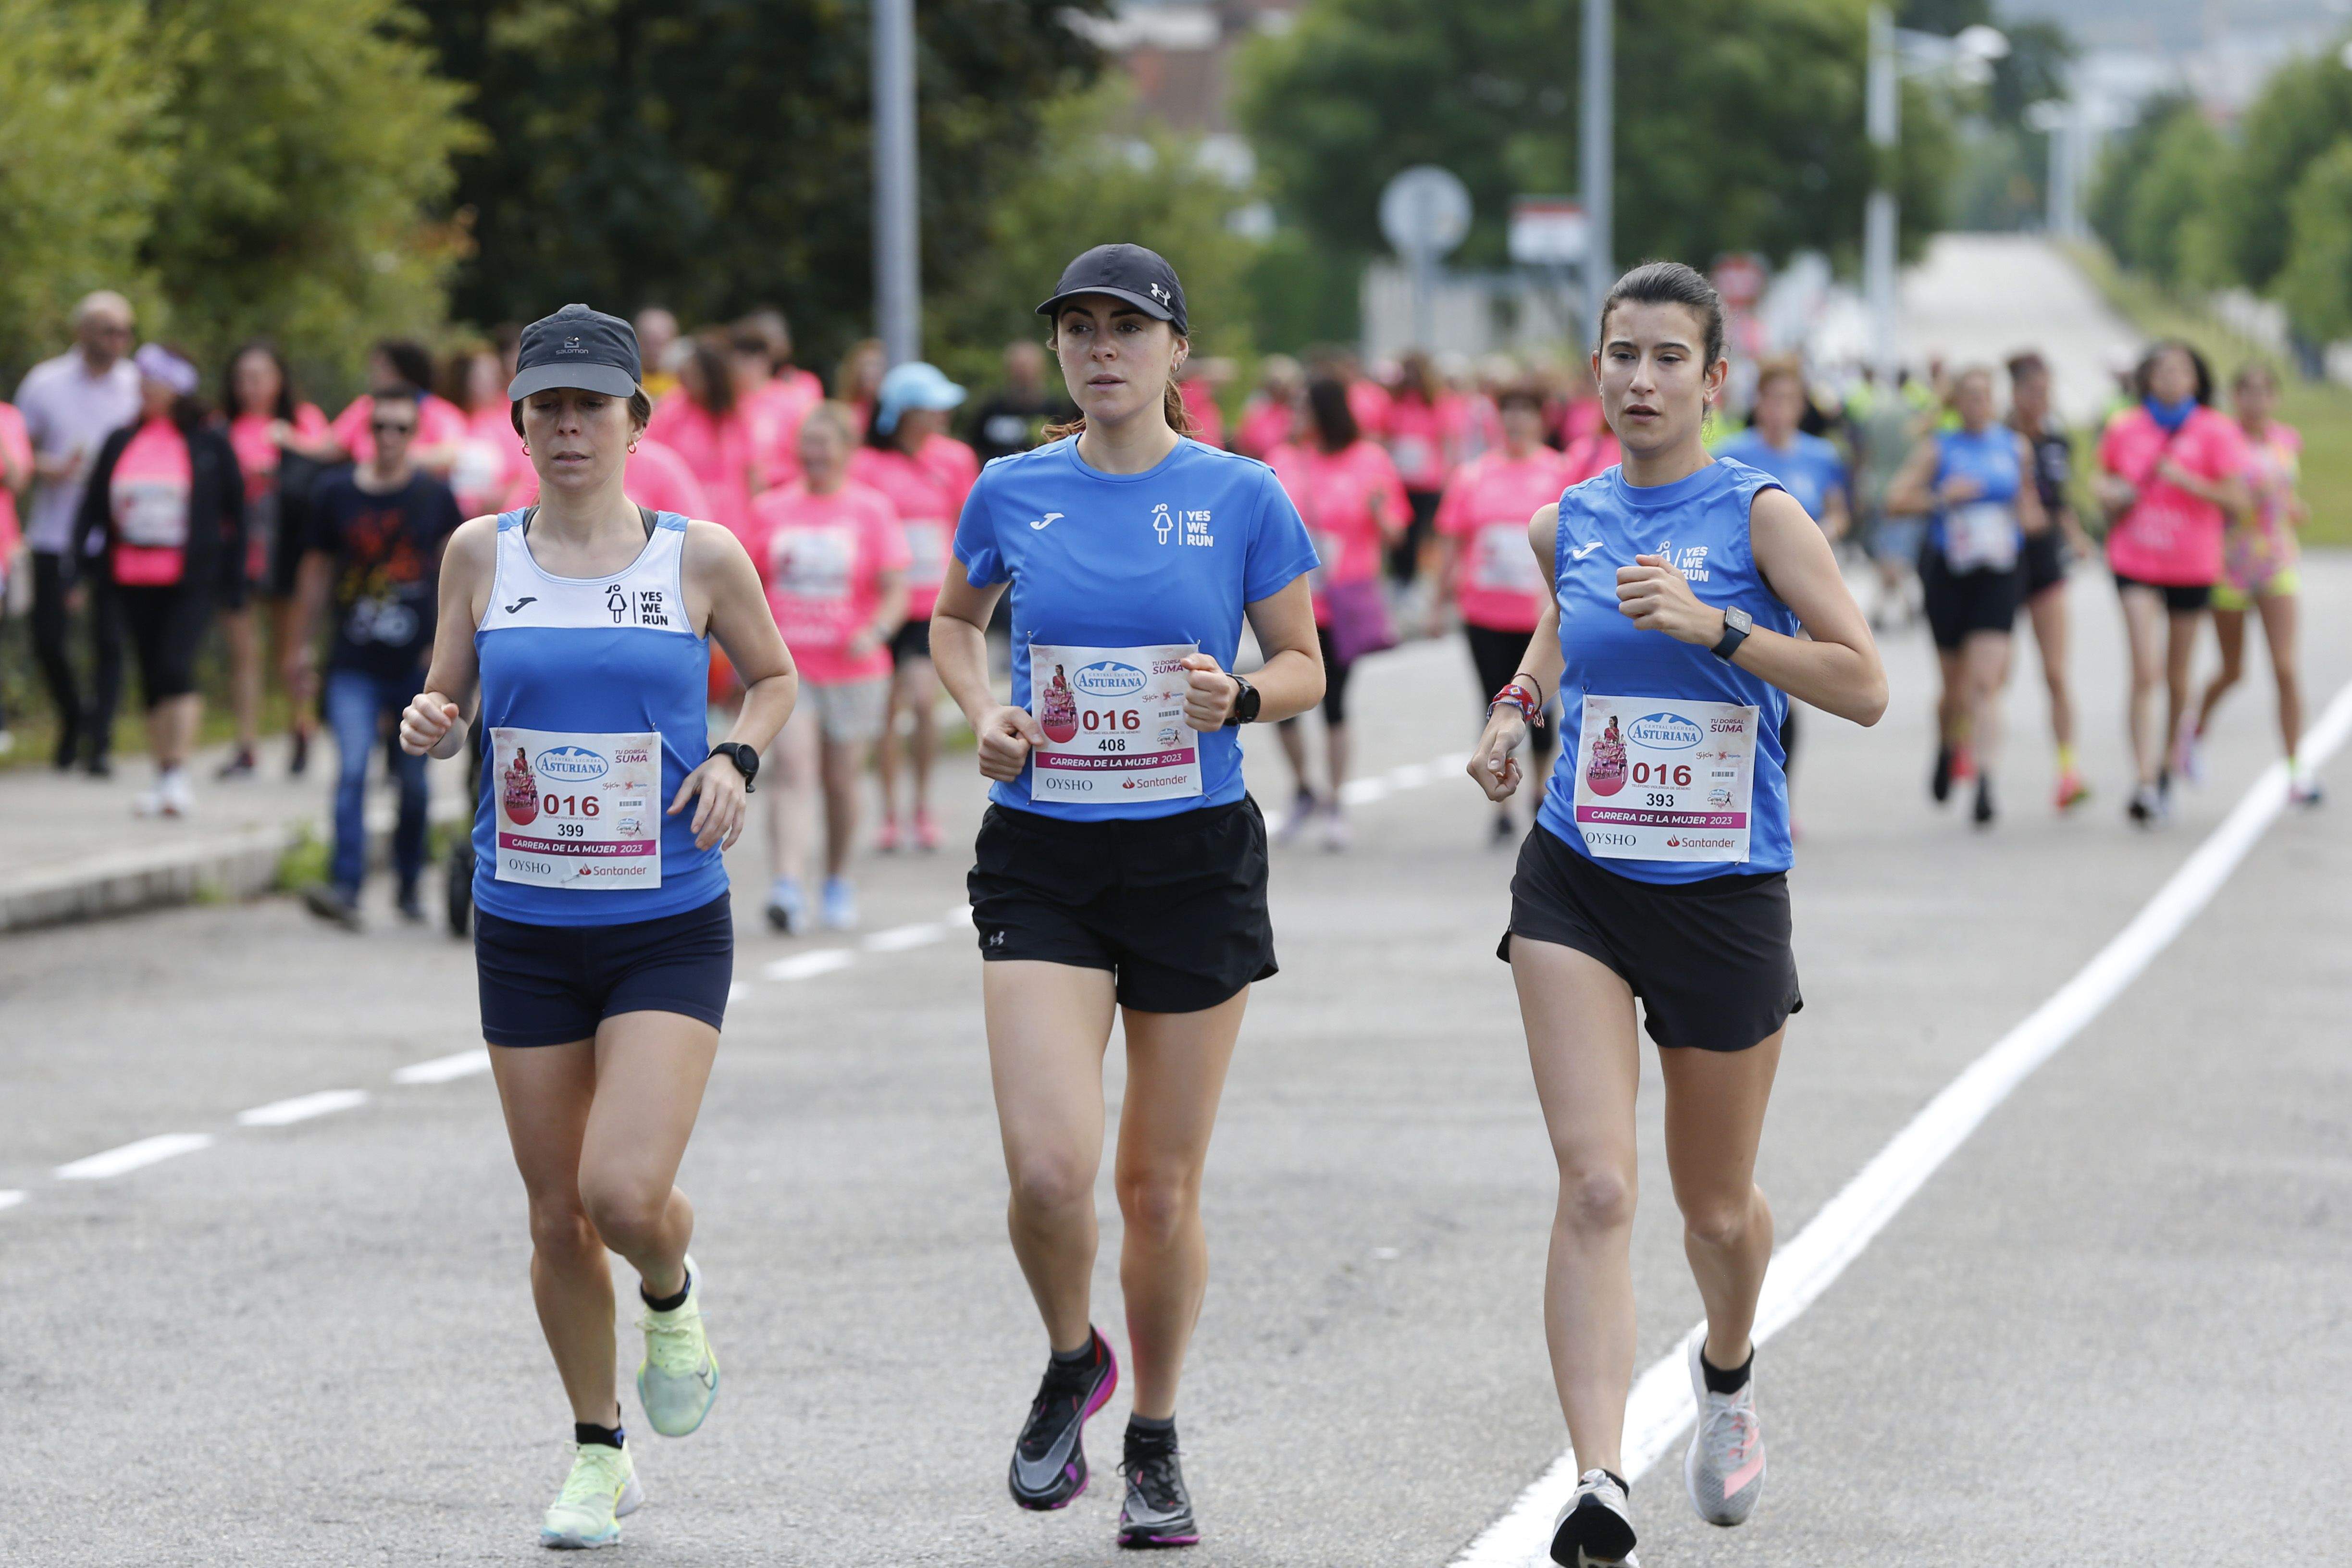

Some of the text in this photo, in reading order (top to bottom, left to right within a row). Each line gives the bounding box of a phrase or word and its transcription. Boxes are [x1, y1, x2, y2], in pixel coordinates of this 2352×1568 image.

[1187, 510, 1211, 521] YES
[1187, 522, 1208, 534] WE
[1187, 534, 1213, 547] RUN
[1686, 546, 1708, 557] YES
[1683, 557, 1704, 568] WE
[1681, 569, 1709, 582] RUN
[640, 592, 662, 602] YES
[641, 604, 661, 613] WE
[643, 615, 668, 625] RUN
[1152, 664, 1184, 675] SUMA
[1079, 673, 1142, 687] ASTURIANA
[1083, 710, 1140, 730] 016
[1633, 725, 1697, 741] ASTURIANA
[1710, 724, 1743, 732] SUMA
[1098, 739, 1126, 751] 408
[541, 757, 603, 773] ASTURIANA
[615, 754, 647, 763] SUMA
[1050, 757, 1091, 767] CARRERA
[1125, 757, 1158, 766] MUJER
[1161, 753, 1182, 763] 2023
[1633, 763, 1691, 786] 016
[1046, 775, 1187, 791] OYSHO Santander
[544, 794, 599, 816] 016
[1646, 793, 1674, 807] 393
[1591, 811, 1733, 825] CARRERA DE LA MUJER 2023
[557, 824, 583, 837] 399
[512, 839, 550, 851] CARRERA
[582, 845, 617, 853] MUJER
[620, 844, 643, 853] 2023
[1586, 832, 1735, 848] OYSHO Santander
[509, 858, 647, 876] OYSHO Santander
